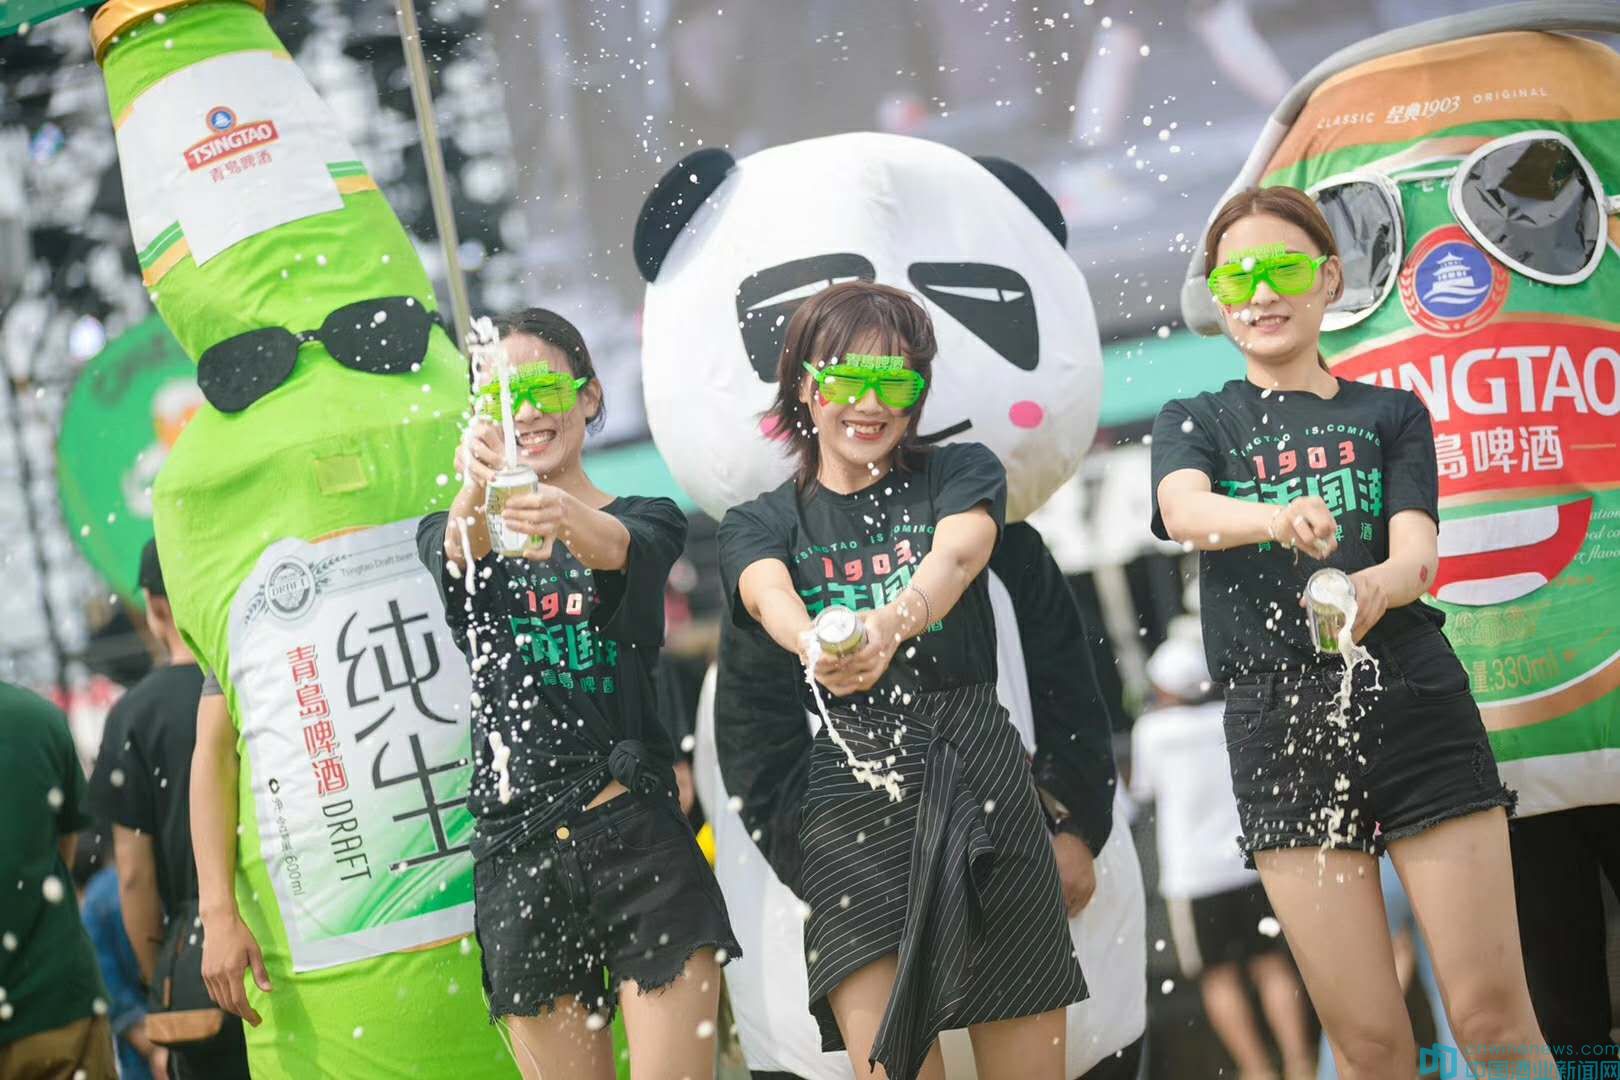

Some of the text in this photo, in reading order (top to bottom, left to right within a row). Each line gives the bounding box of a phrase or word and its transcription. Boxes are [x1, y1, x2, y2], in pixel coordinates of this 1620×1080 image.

[1473, 86, 1549, 104] ORIGINAL
[1316, 112, 1376, 129] CLASSIC
[190, 123, 273, 164] TSINGTAO
[1354, 345, 1620, 423] NGTAO
[1252, 440, 1356, 480] 1903
[870, 533, 884, 544] IS
[821, 539, 914, 582] 1903
[336, 598, 471, 872] 纯生
[321, 798, 372, 882] DRAFT
